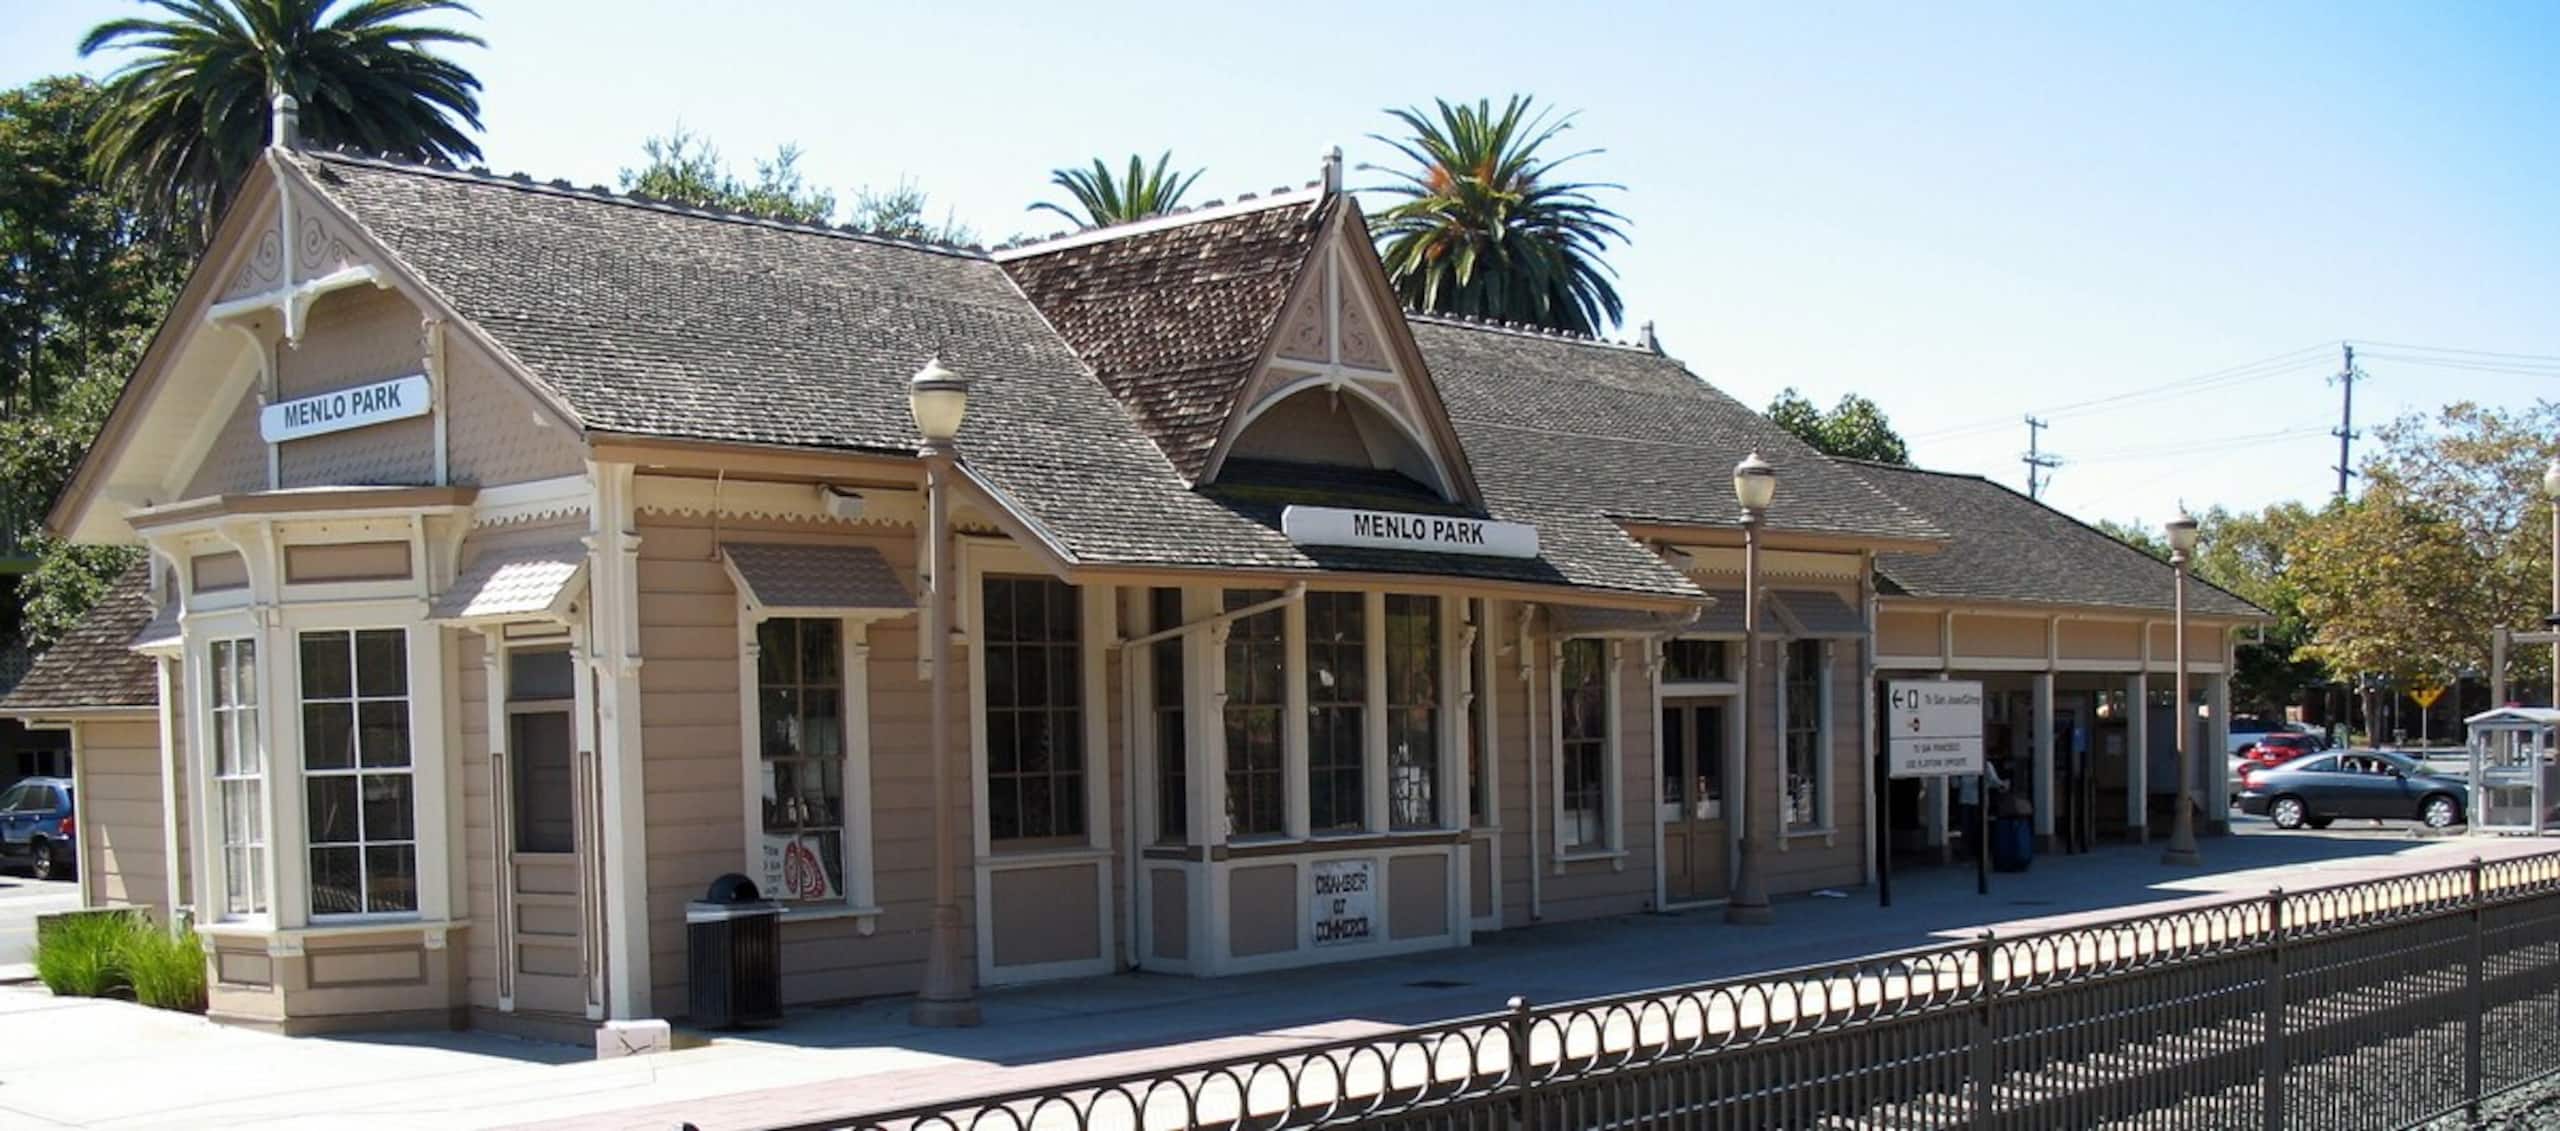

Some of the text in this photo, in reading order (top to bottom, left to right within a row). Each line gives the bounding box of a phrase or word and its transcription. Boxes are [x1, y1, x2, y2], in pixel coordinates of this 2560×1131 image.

[285, 383, 402, 428] MENLO PARK
[1354, 514, 1485, 544] MENLO PARK
